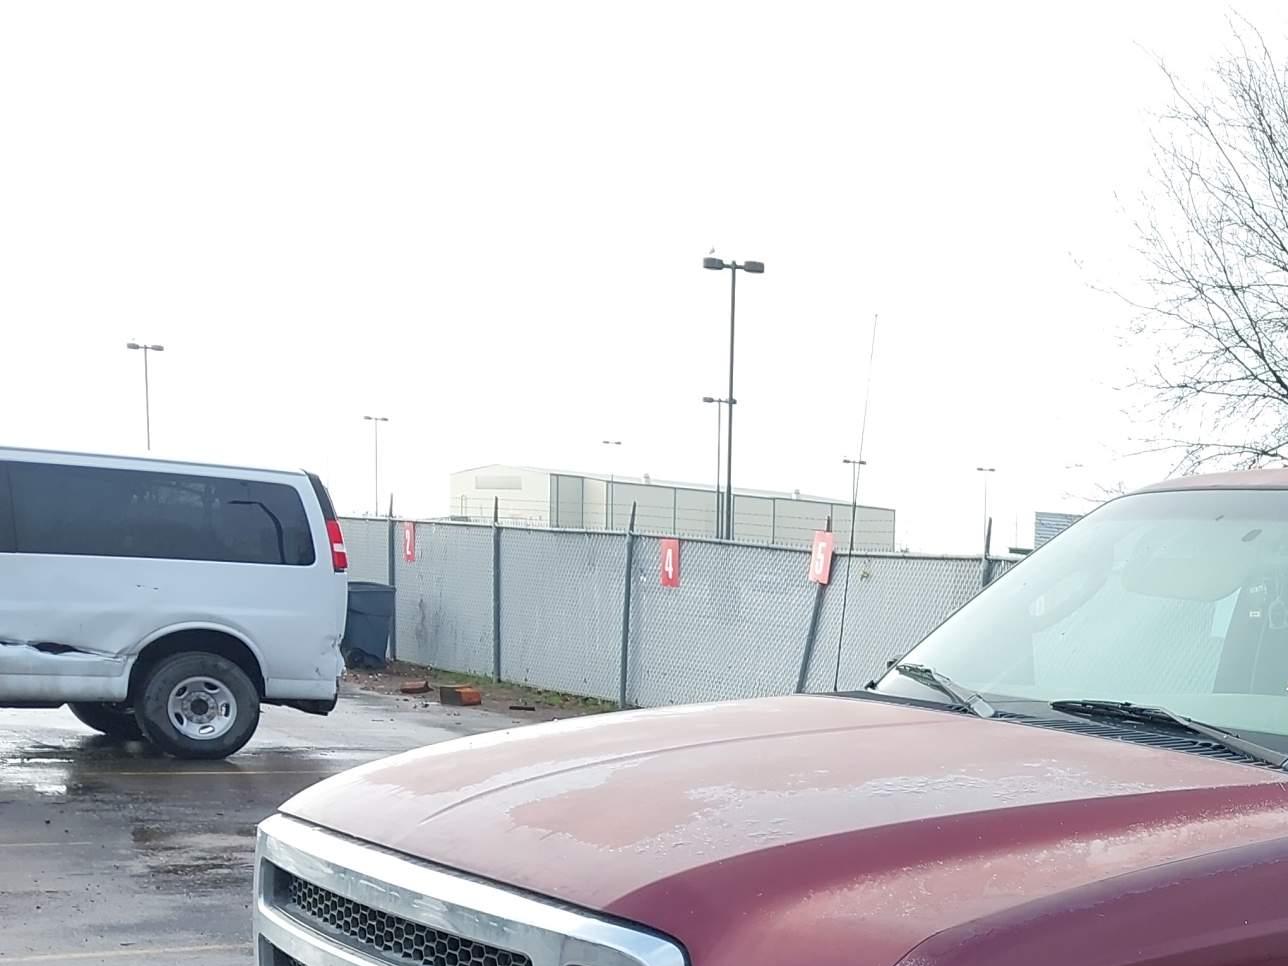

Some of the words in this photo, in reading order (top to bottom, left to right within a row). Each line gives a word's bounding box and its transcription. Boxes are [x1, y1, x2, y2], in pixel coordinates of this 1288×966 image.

[405, 529, 412, 556] 2
[664, 548, 674, 580] 4
[814, 542, 827, 576] 5
